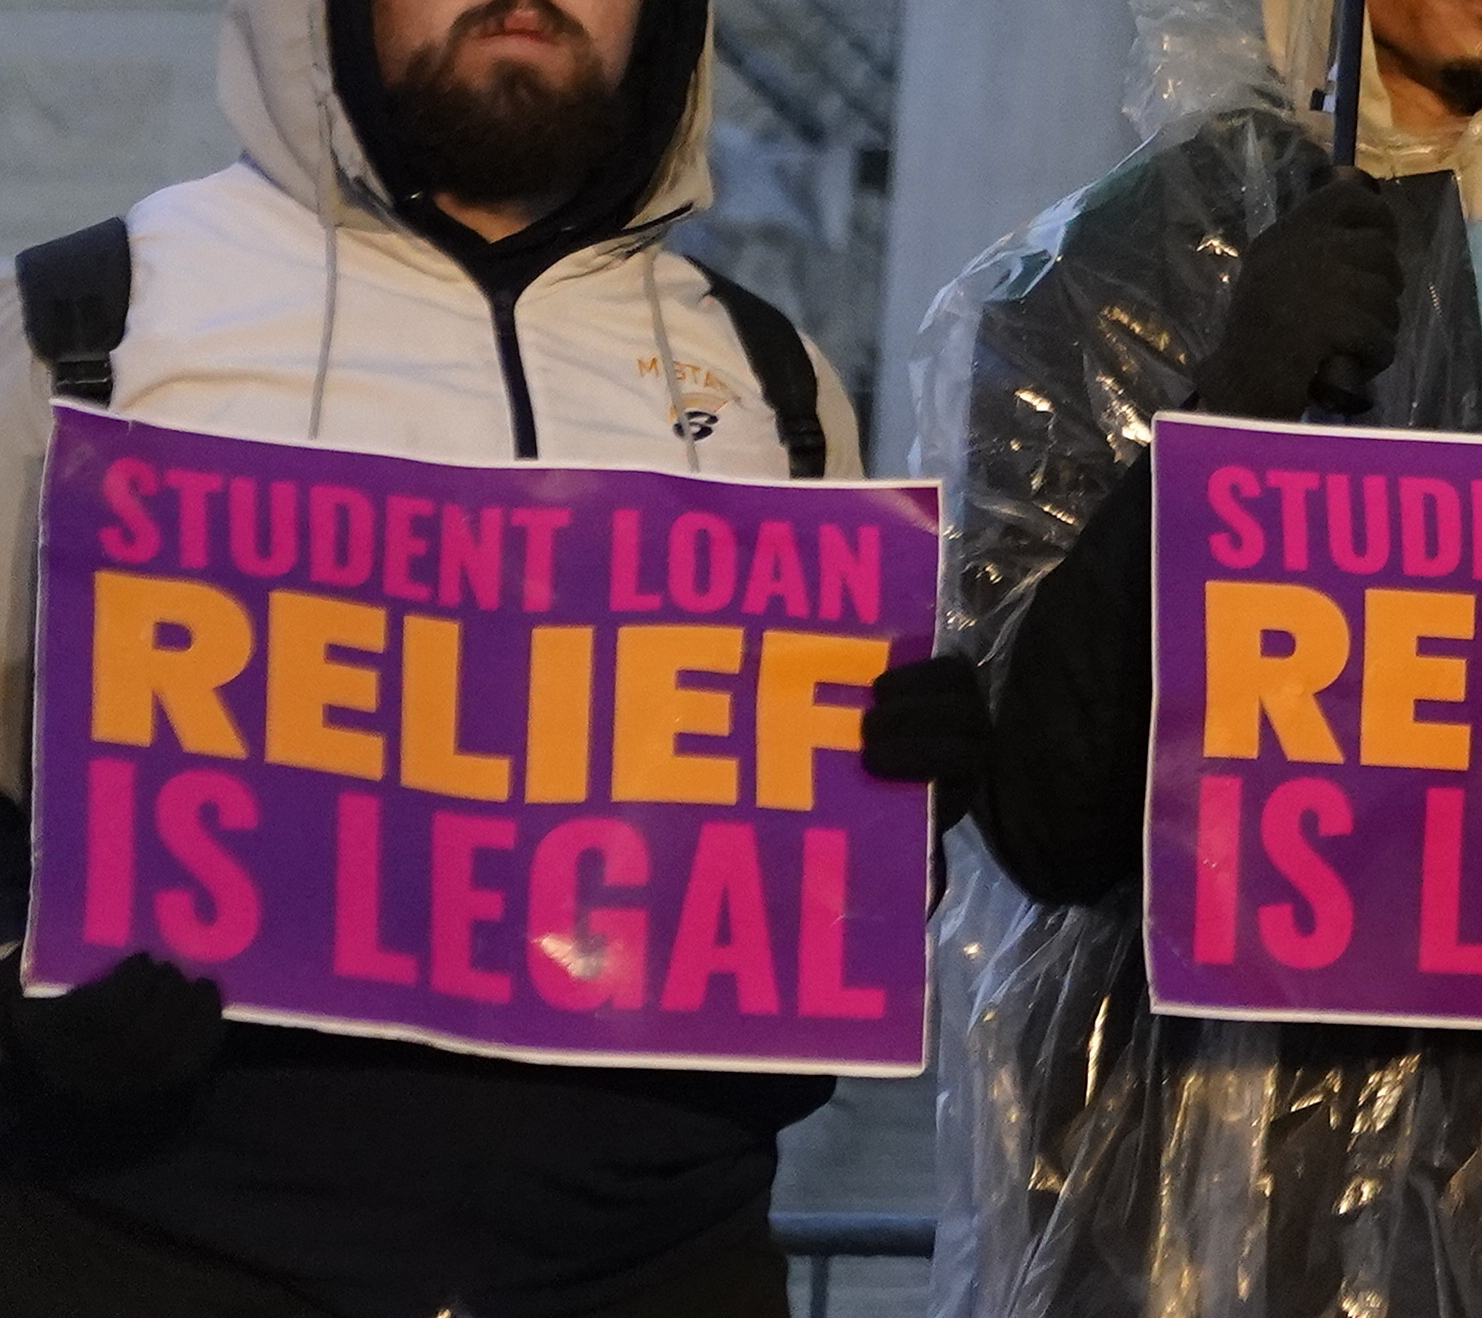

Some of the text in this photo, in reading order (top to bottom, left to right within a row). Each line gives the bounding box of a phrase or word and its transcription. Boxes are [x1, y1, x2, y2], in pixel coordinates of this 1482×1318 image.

[103, 460, 879, 623] STUDENT LOAN
[92, 571, 891, 811] RELIEF
[83, 757, 886, 1020] IS LEGAL
[1195, 775, 1355, 969] IS
